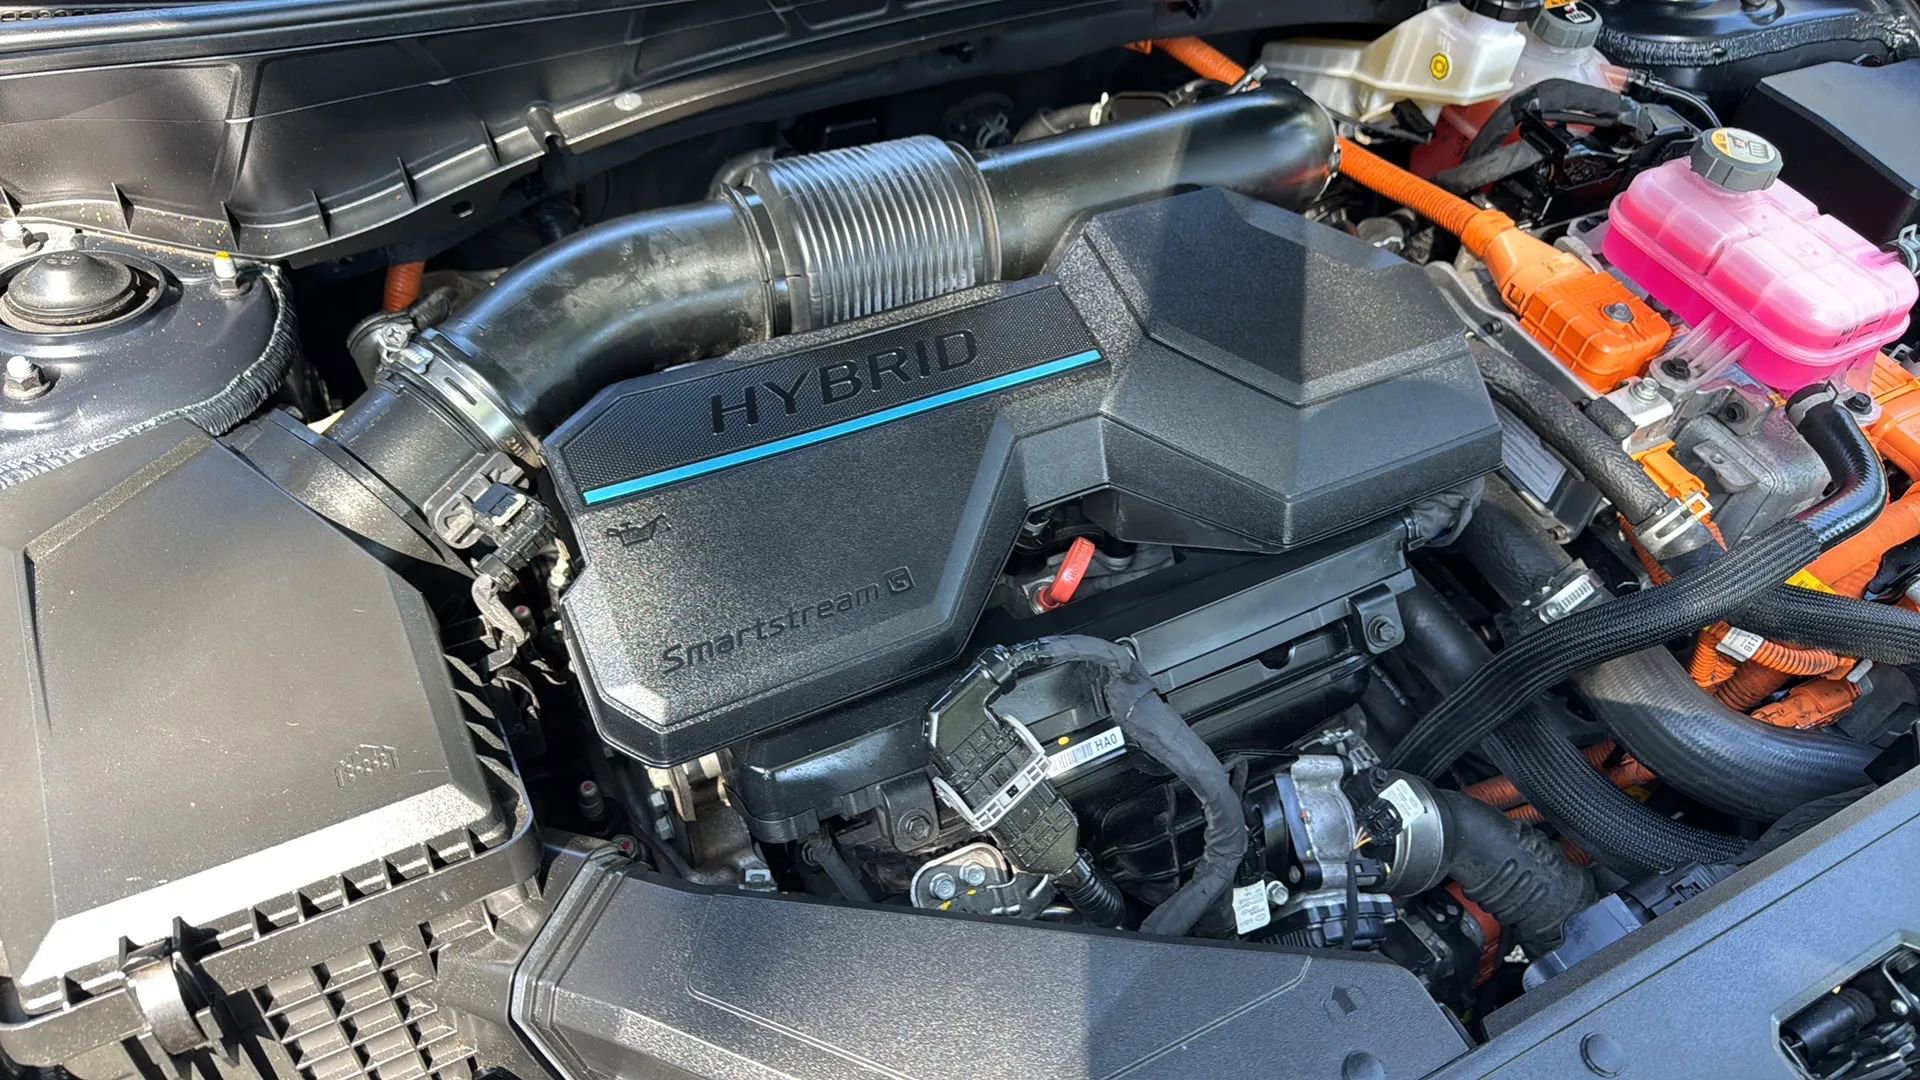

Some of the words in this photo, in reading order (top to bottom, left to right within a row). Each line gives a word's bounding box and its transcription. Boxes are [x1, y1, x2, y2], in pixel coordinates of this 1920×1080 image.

[711, 329, 978, 435] HYBRID
[662, 583, 880, 675] Smartstream
[885, 565, 917, 596] G
